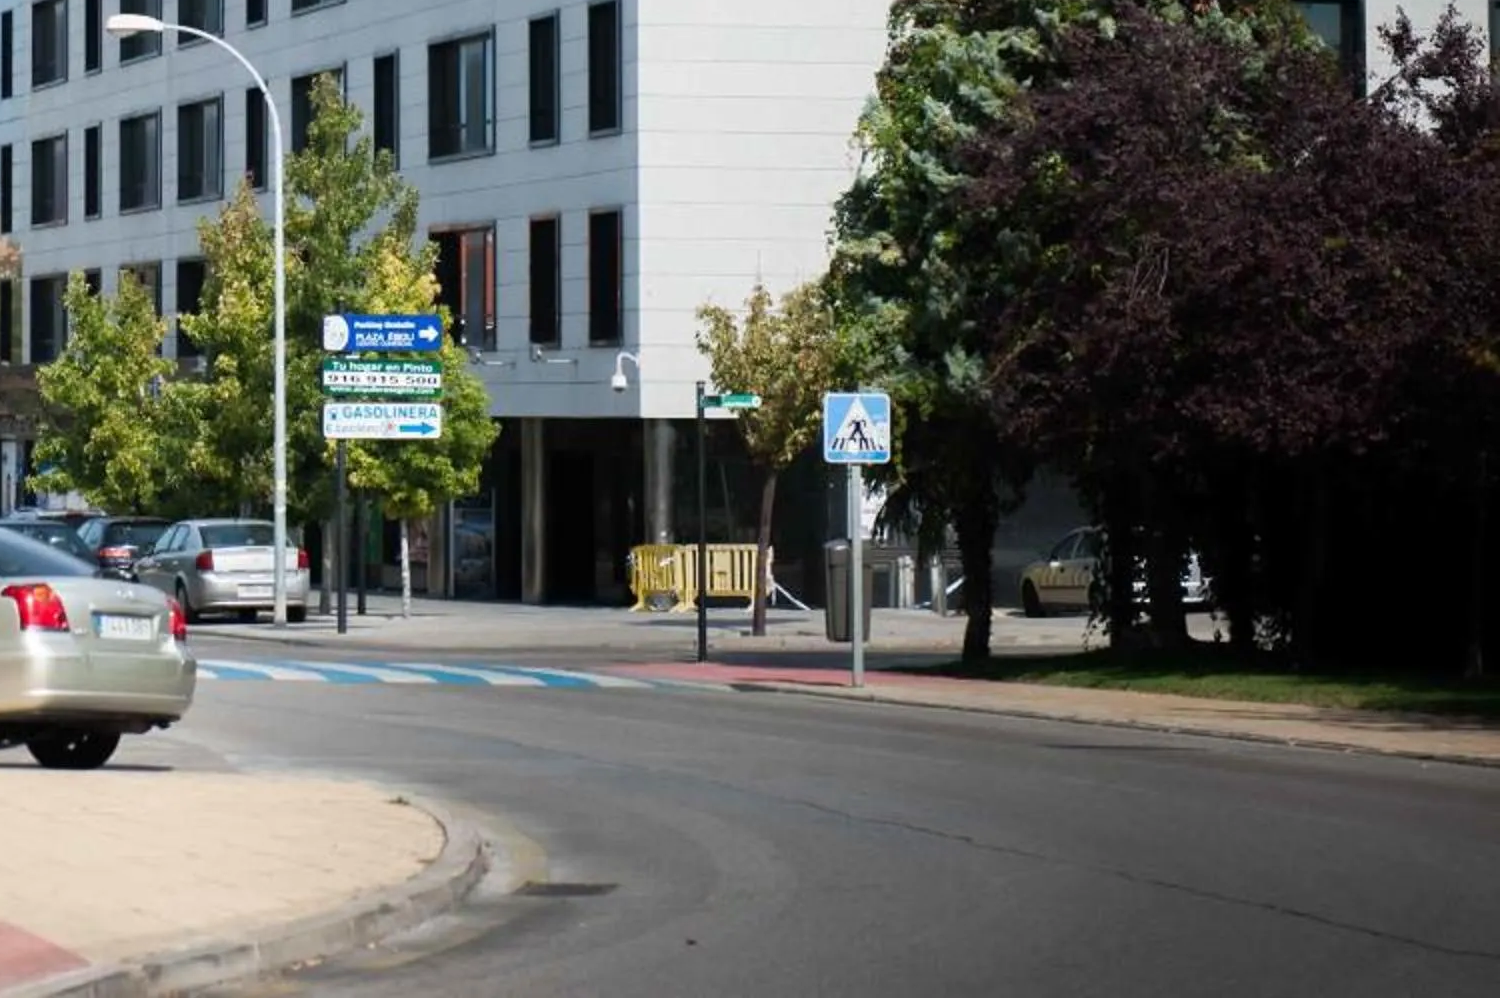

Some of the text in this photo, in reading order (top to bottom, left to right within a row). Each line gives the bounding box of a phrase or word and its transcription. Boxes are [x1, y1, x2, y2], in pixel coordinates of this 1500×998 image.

[332, 361, 347, 369] Tu
[349, 361, 382, 372] hogar
[403, 363, 433, 373] Pinto
[342, 406, 438, 419] GASOLINERA
